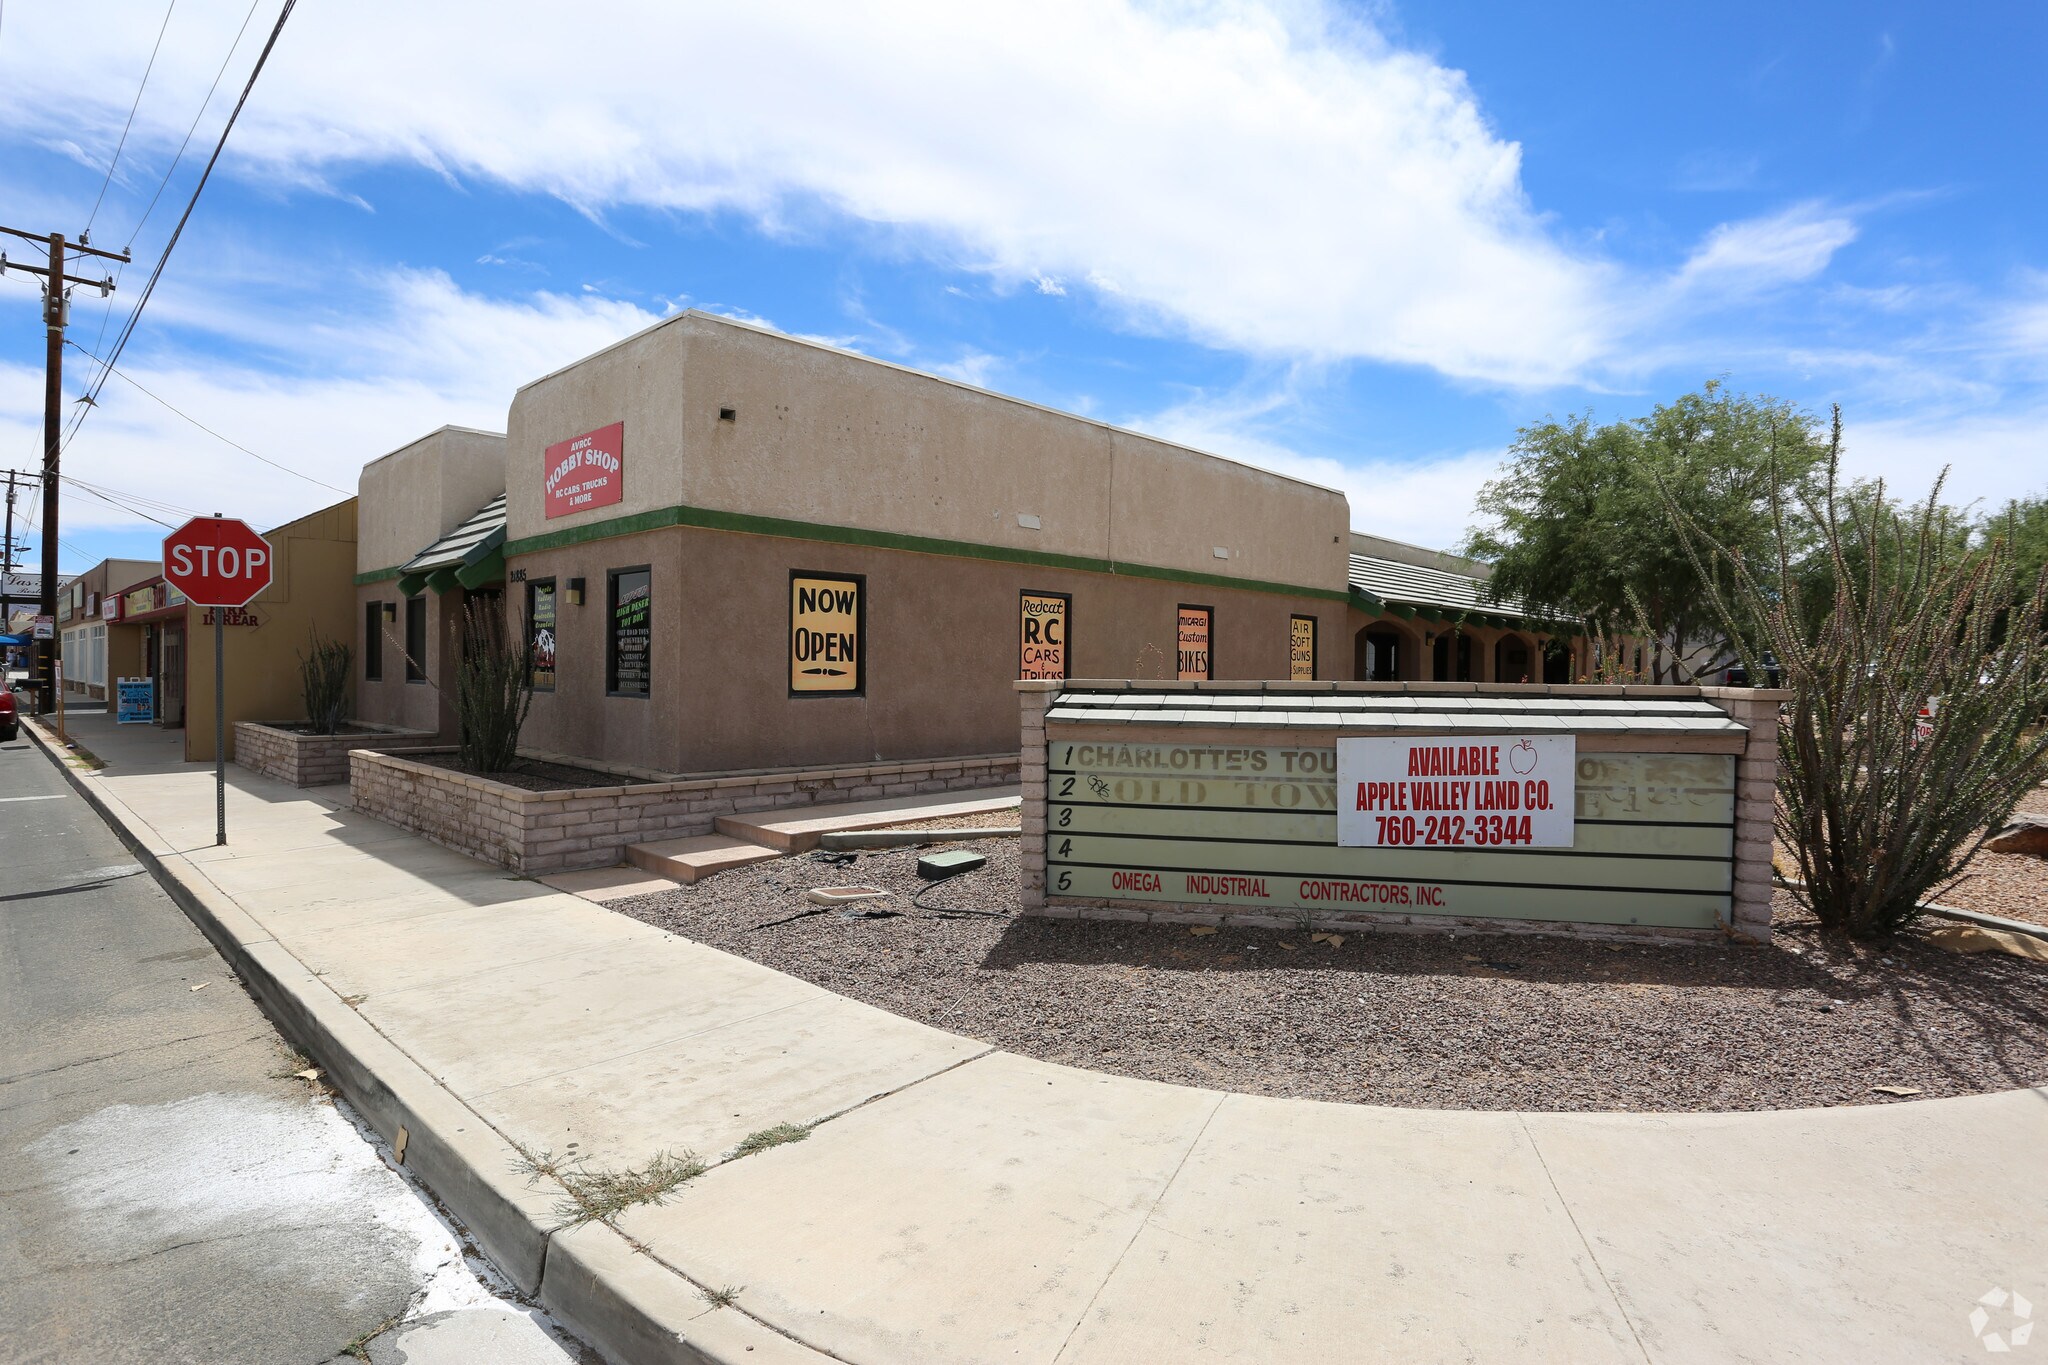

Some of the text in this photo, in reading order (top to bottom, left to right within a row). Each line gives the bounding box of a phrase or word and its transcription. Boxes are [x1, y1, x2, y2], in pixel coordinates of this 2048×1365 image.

[571, 437, 592, 452] AVRCC
[546, 449, 619, 494] HOBBY SHOP
[555, 489, 564, 498] RC
[582, 477, 608, 491] TRUCKS
[569, 492, 592, 506] & MORE
[171, 544, 266, 578] STOP
[208, 605, 249, 615] PRK
[616, 597, 649, 618] HIGH DESER
[799, 587, 855, 615] NOW
[1023, 600, 1063, 616] Redcat
[222, 615, 259, 626] REAR
[533, 612, 555, 620] Controlle
[632, 612, 643, 624] BOX
[1024, 617, 1062, 645] R.C.
[1178, 630, 1207, 643] Custom
[1292, 621, 1309, 633] AIR
[795, 627, 854, 662] OPEN
[1291, 634, 1310, 647] SOFT
[1023, 647, 1060, 664] CARS
[1178, 650, 1207, 673] BIKES
[1291, 648, 1310, 661] GUNS
[1065, 746, 1074, 766] 1
[1077, 745, 1268, 772] CHARLOTTE'S
[1281, 751, 1338, 775] TOU
[1408, 745, 1500, 777] AVAILABLE
[1058, 777, 1076, 796] 2
[1114, 779, 1207, 804] OLD
[1234, 782, 1338, 809] TOW
[1356, 782, 1407, 812] APPLE
[1410, 781, 1471, 811] VALLEY
[1474, 780, 1520, 810] LAND
[1524, 780, 1554, 810] CO.
[1058, 808, 1072, 826] 3
[1375, 815, 1533, 845] 760-242-3344
[1058, 838, 1072, 857] 4
[1058, 871, 1446, 908] 5 OMEGA INDUSTRIAL CONTRACTORS, INC.
